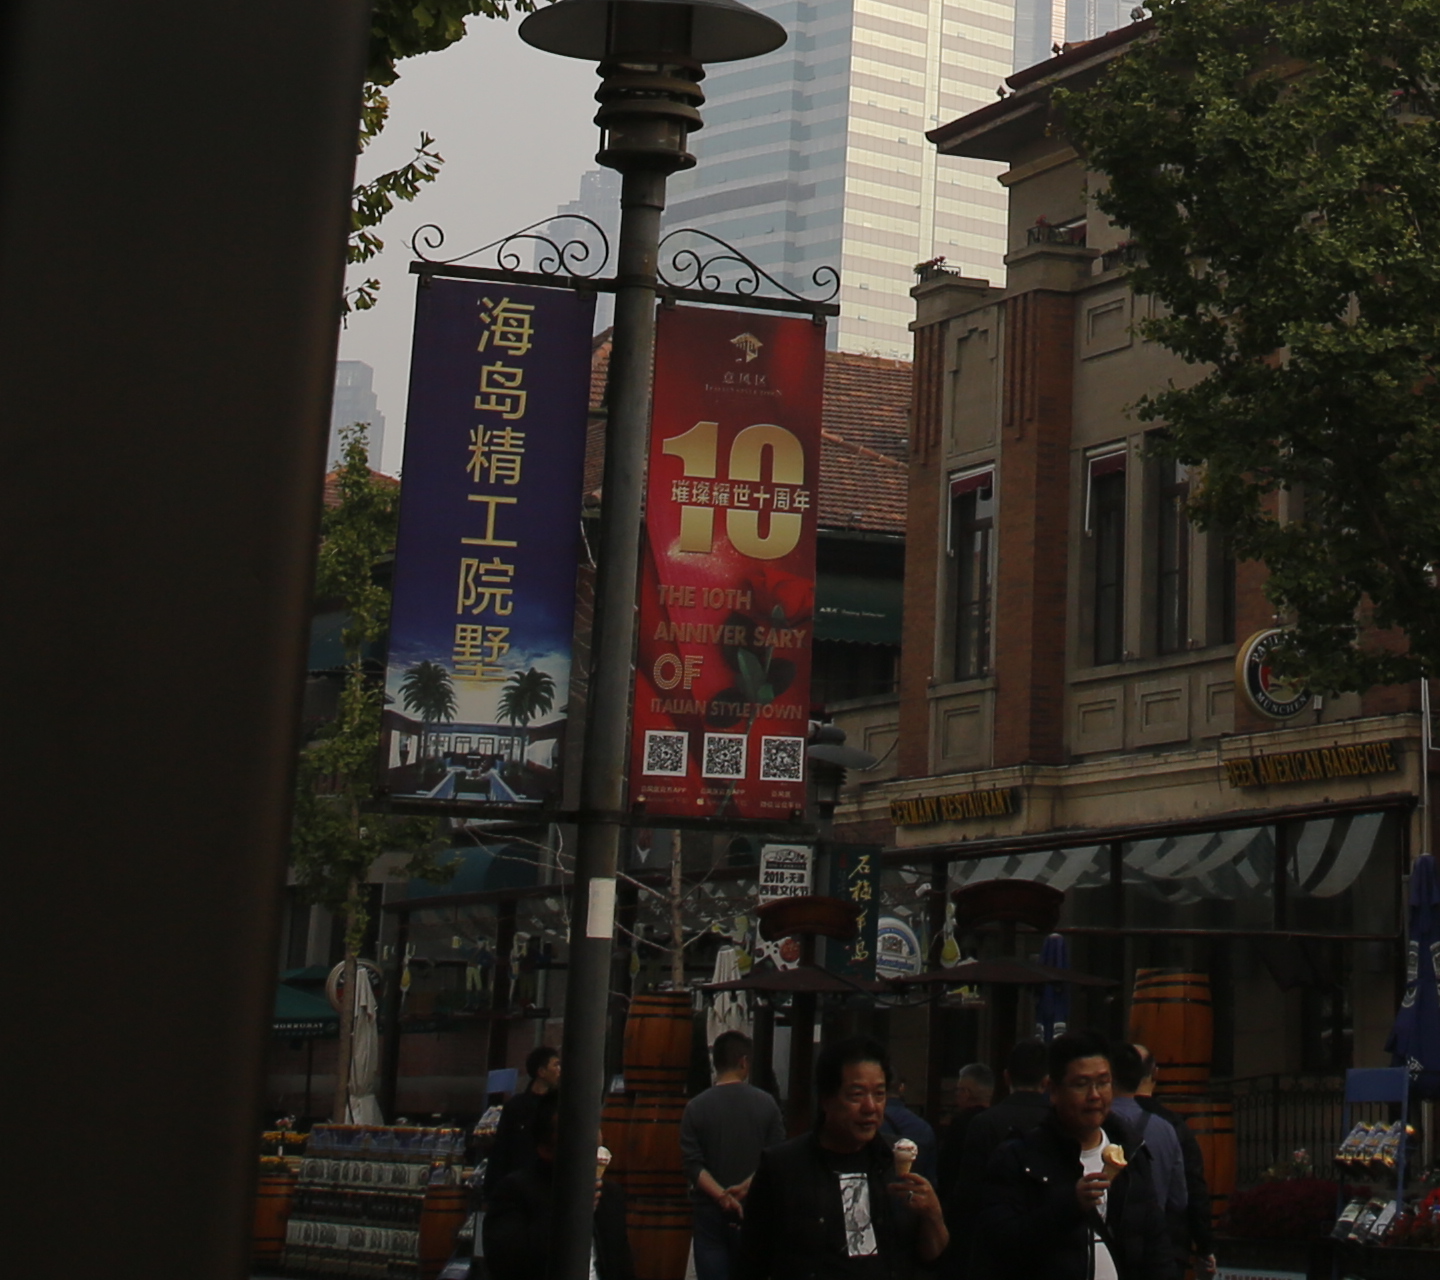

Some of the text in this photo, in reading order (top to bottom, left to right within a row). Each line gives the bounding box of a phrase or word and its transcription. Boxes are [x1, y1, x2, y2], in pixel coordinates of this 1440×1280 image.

[450, 297, 536, 684] 海岛精工院墅
[662, 420, 805, 561] 10
[670, 479, 811, 513] 璀璨耀世十周年
[656, 584, 752, 611] THE 10TH
[653, 621, 807, 649] ANNIVER SARY
[652, 652, 704, 690] OF
[650, 697, 803, 720] ITALIAN STYLE TOWN
[1255, 691, 1308, 715] MÜNCHEN
[1224, 741, 1397, 788] BEER AMERICAN BARBECUE
[889, 787, 1016, 827] GERMANY RESTAURANT
